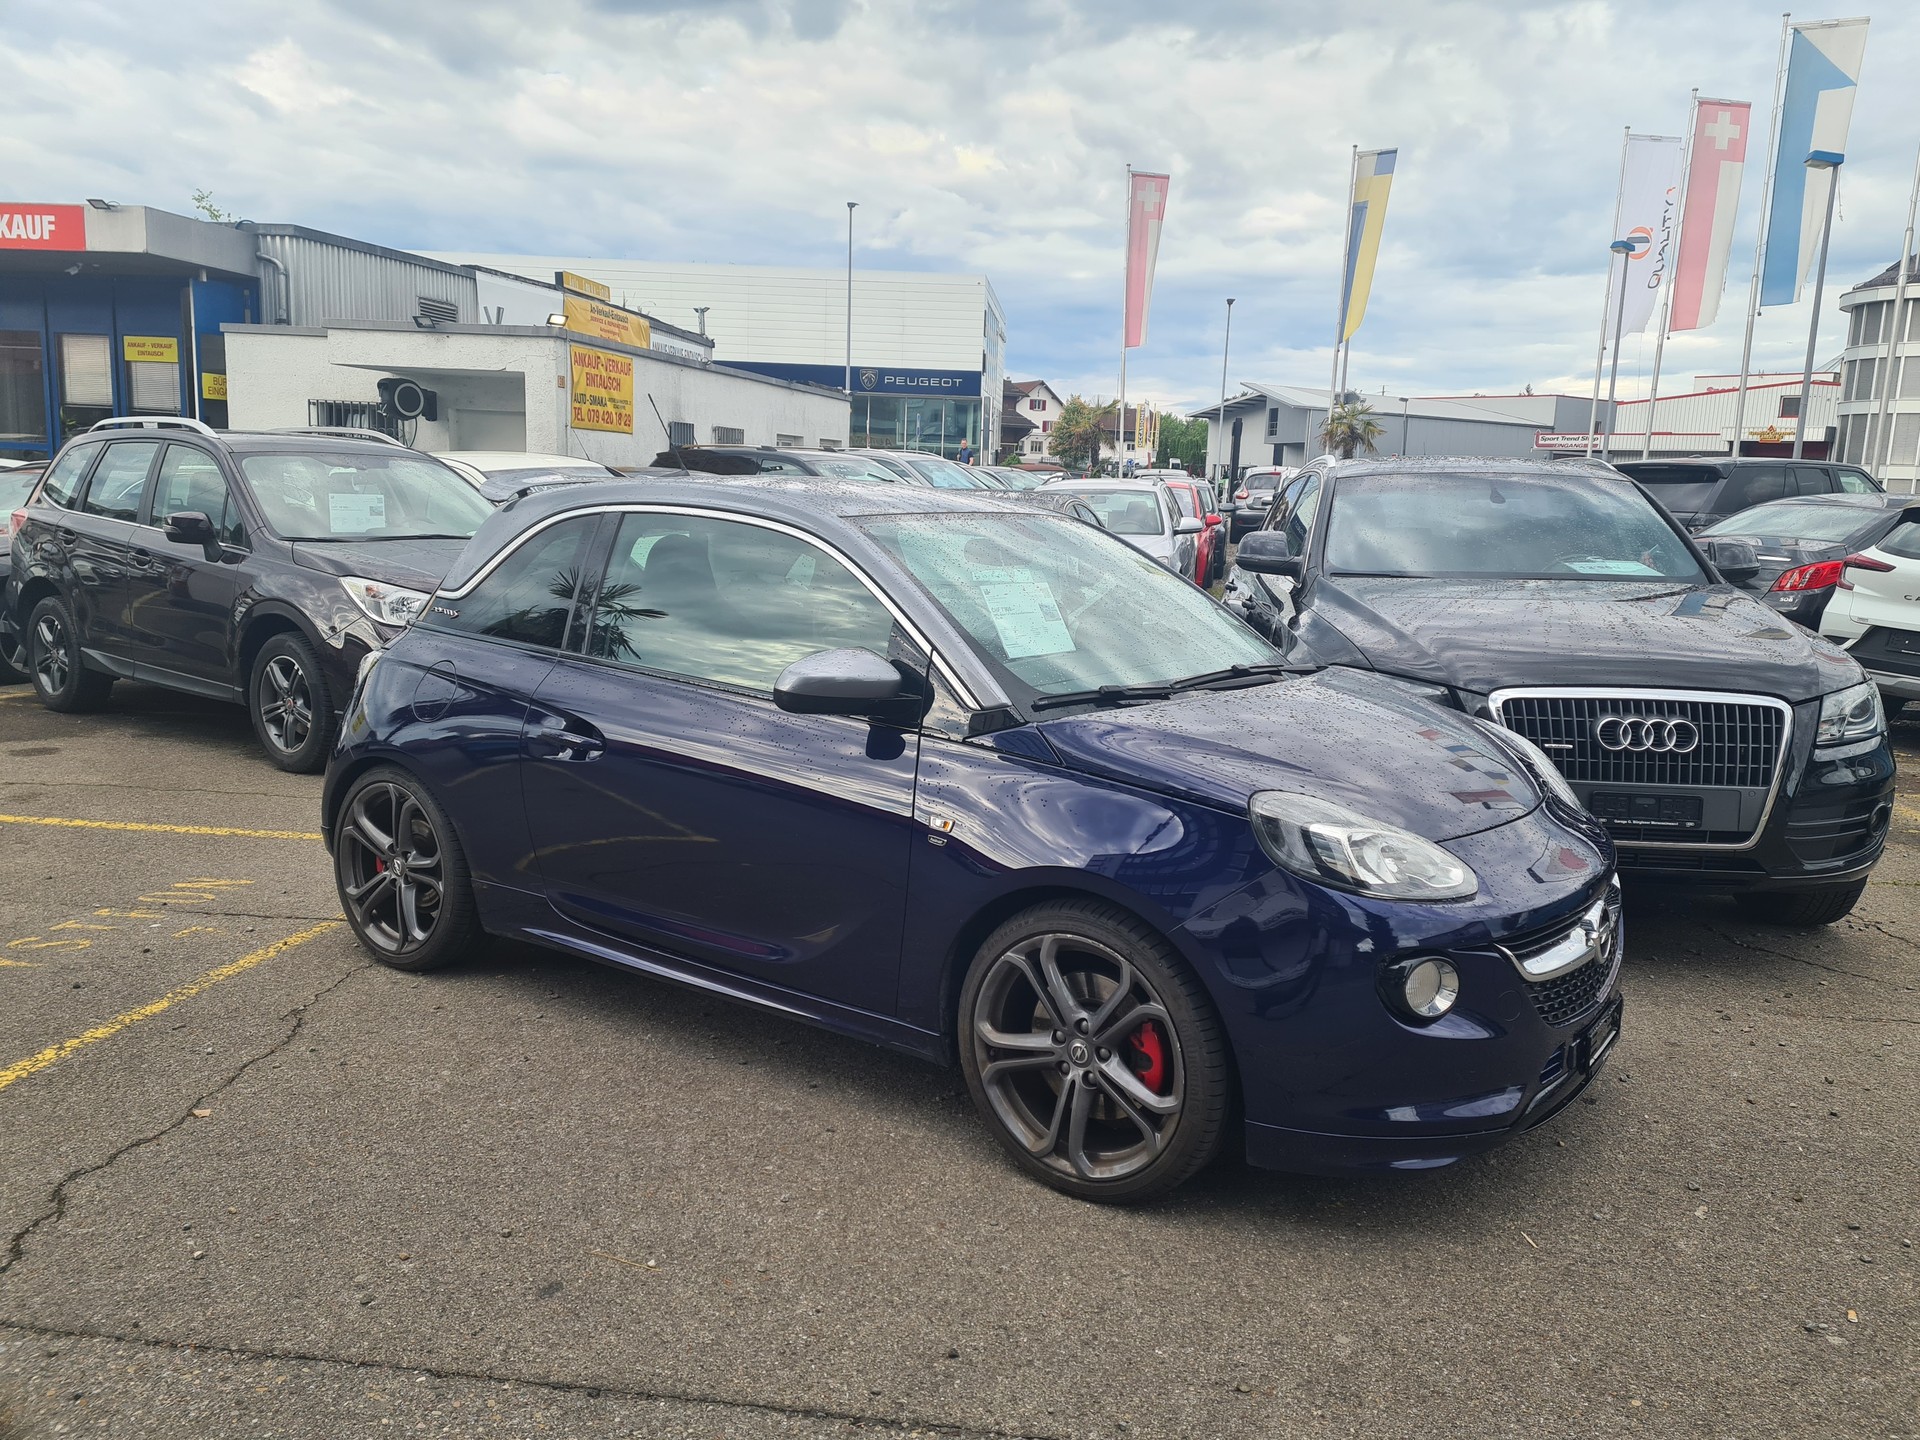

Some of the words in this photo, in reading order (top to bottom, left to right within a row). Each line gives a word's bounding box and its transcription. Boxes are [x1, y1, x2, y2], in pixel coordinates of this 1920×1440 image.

[585, 371, 621, 392] EINTAUSCH
[884, 375, 963, 387] PEUGEOT
[587, 409, 600, 424] 079
[601, 411, 614, 425] 420
[615, 412, 623, 426] 18
[1540, 435, 1560, 443] Sport
